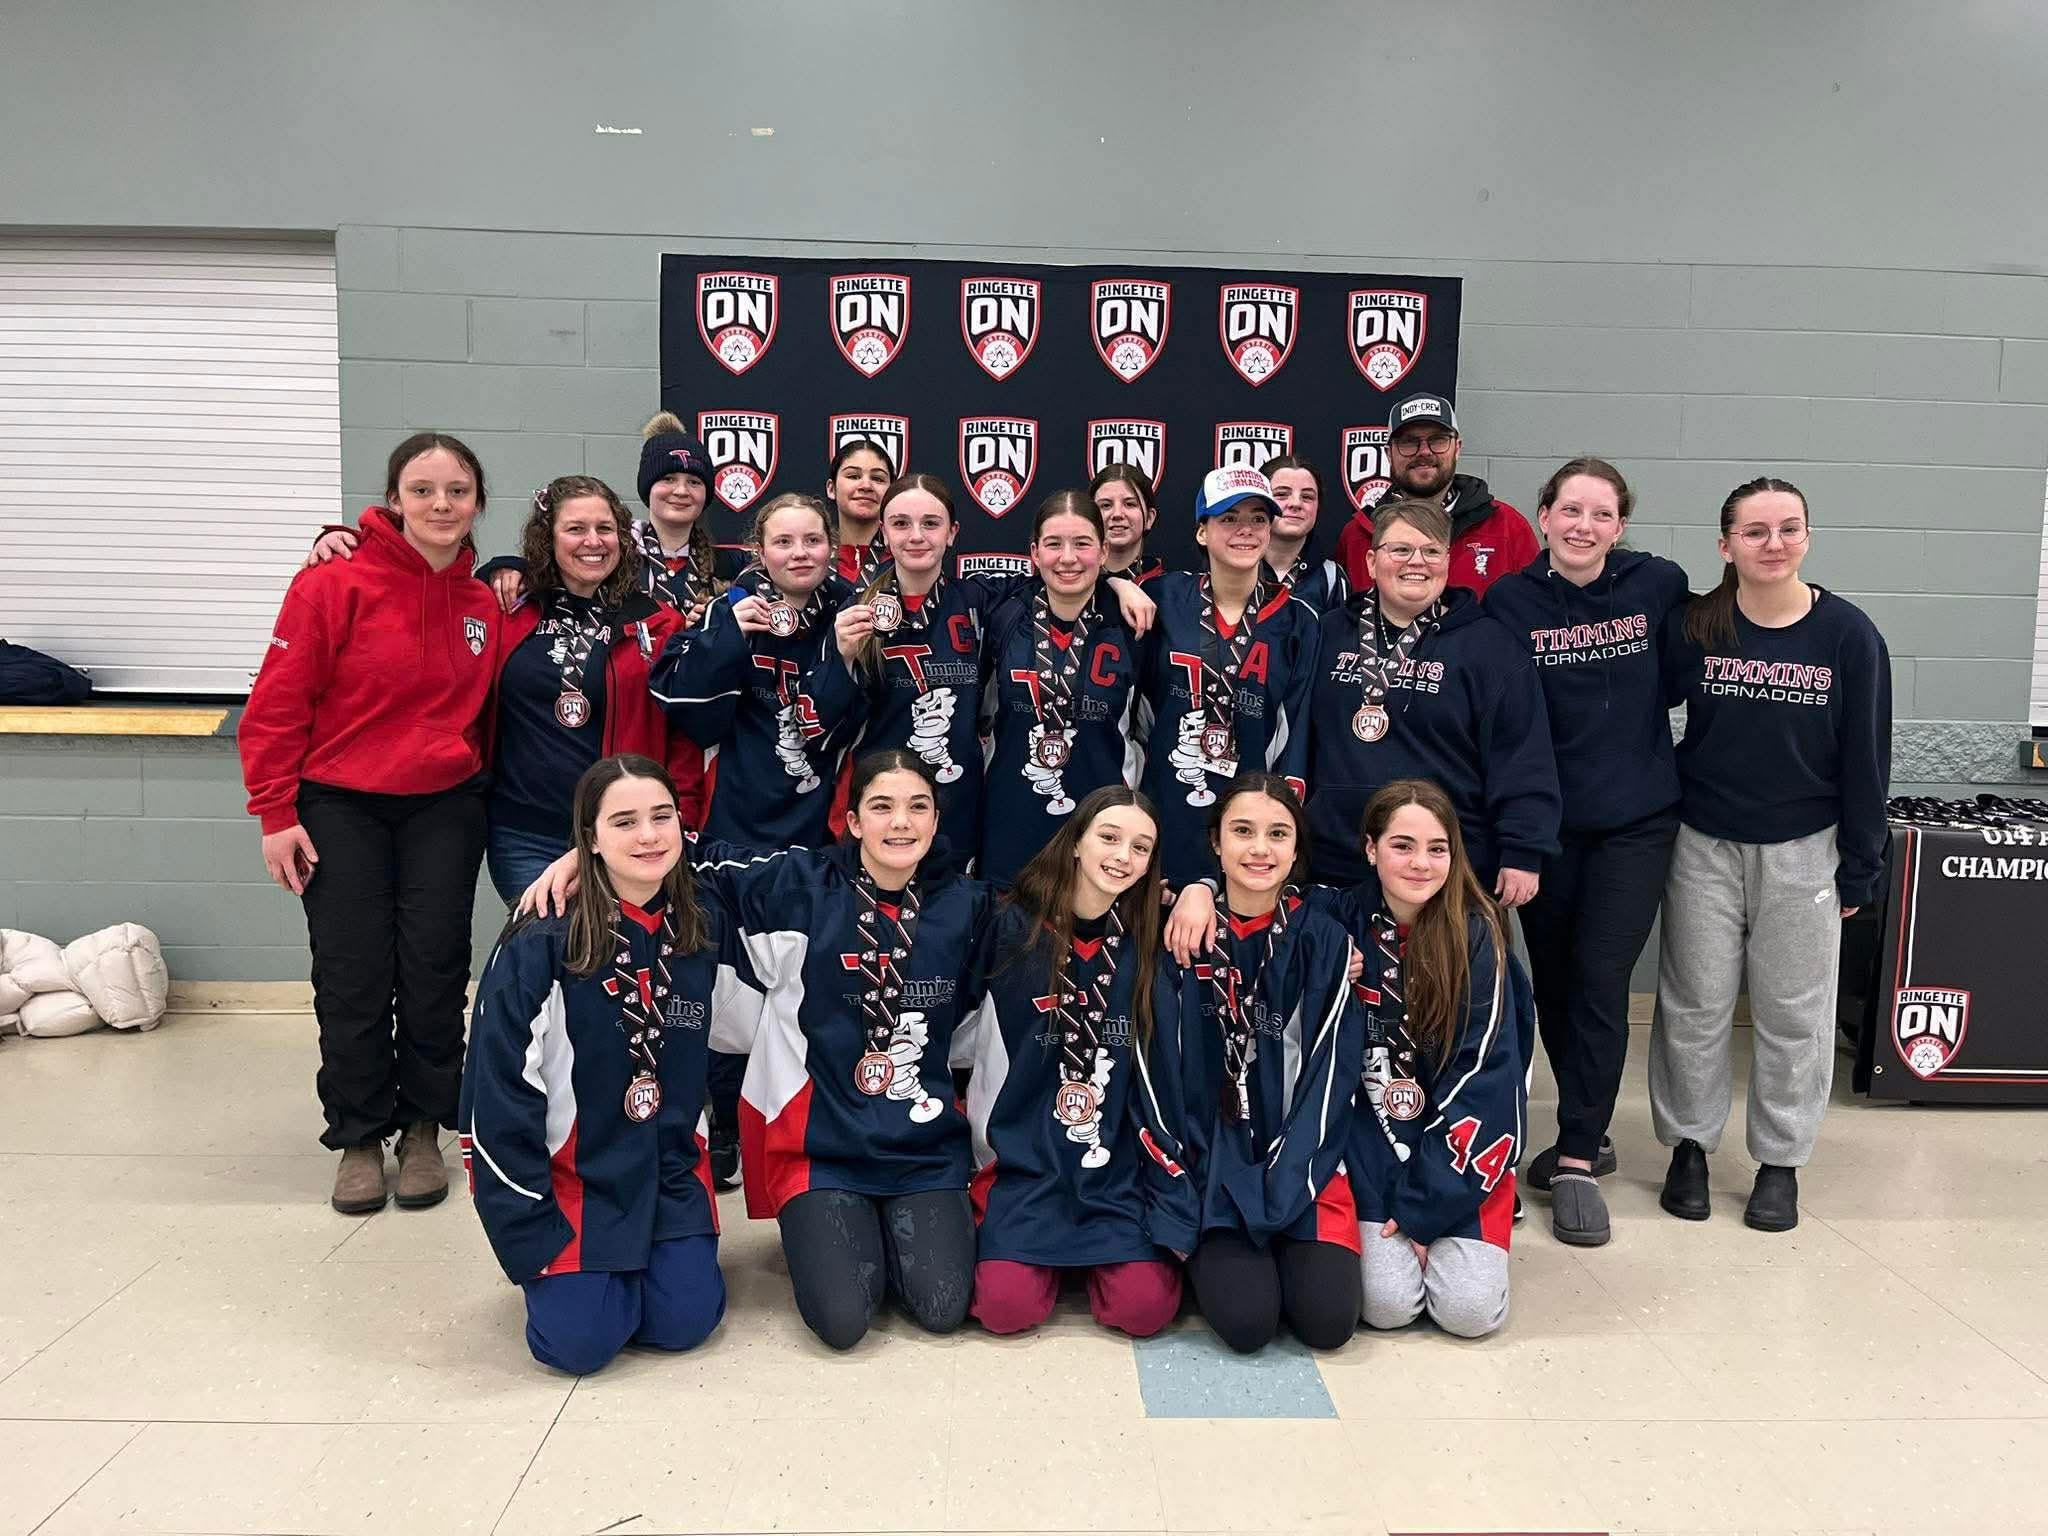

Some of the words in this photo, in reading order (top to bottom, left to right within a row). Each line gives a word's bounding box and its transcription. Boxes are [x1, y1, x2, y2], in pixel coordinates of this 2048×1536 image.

[704, 275, 771, 291] RINGETTE
[836, 277, 904, 293] RINGETTE
[968, 282, 1034, 297] RINGETTE
[1097, 283, 1164, 299] RINGETTE
[1227, 288, 1293, 304] RINGETTE
[1355, 293, 1421, 309] RINGETTE
[706, 291, 767, 335] ON
[840, 293, 899, 337] ON
[970, 297, 1029, 342] ON
[1100, 299, 1159, 342] ON
[1228, 302, 1287, 346] ON
[1356, 309, 1414, 353] ON
[1402, 402, 1441, 417] INDY-CREW
[704, 415, 772, 431] RINGETTE
[836, 418, 903, 433] RINGETTE
[965, 420, 1031, 436] RINGETTE
[1094, 423, 1160, 438] RINGETTE
[1221, 426, 1287, 441] RINGETTE
[1348, 431, 1388, 444] RINGE
[707, 430, 768, 474] ON
[968, 435, 1027, 480] ON
[1097, 438, 1154, 480] ON
[963, 557, 1029, 572] RINGETTE
[466, 623, 485, 643] ON
[946, 614, 974, 655] C
[1530, 614, 1648, 653] TIMMINS
[1531, 639, 1649, 667] TORNADOES
[1090, 642, 1121, 688] C
[1238, 640, 1270, 686] A
[1336, 652, 1445, 682] TIINS
[1330, 671, 1440, 694] TORDOES
[1704, 656, 1833, 691] TIMMINS
[1700, 682, 1829, 706] TORNADOES
[563, 702, 582, 715] ON
[1208, 734, 1227, 747] ON
[1044, 744, 1062, 758] ON
[1941, 855, 2048, 881] CHAMPI
[1900, 991, 1964, 1005] RINGETTE
[1900, 1004, 1959, 1045] ON
[866, 1064, 887, 1079] ON
[635, 1089, 654, 1106] ON
[1066, 1093, 1088, 1109] ON
[1392, 1091, 1415, 1105] ON
[1445, 1115, 1516, 1193] 44
